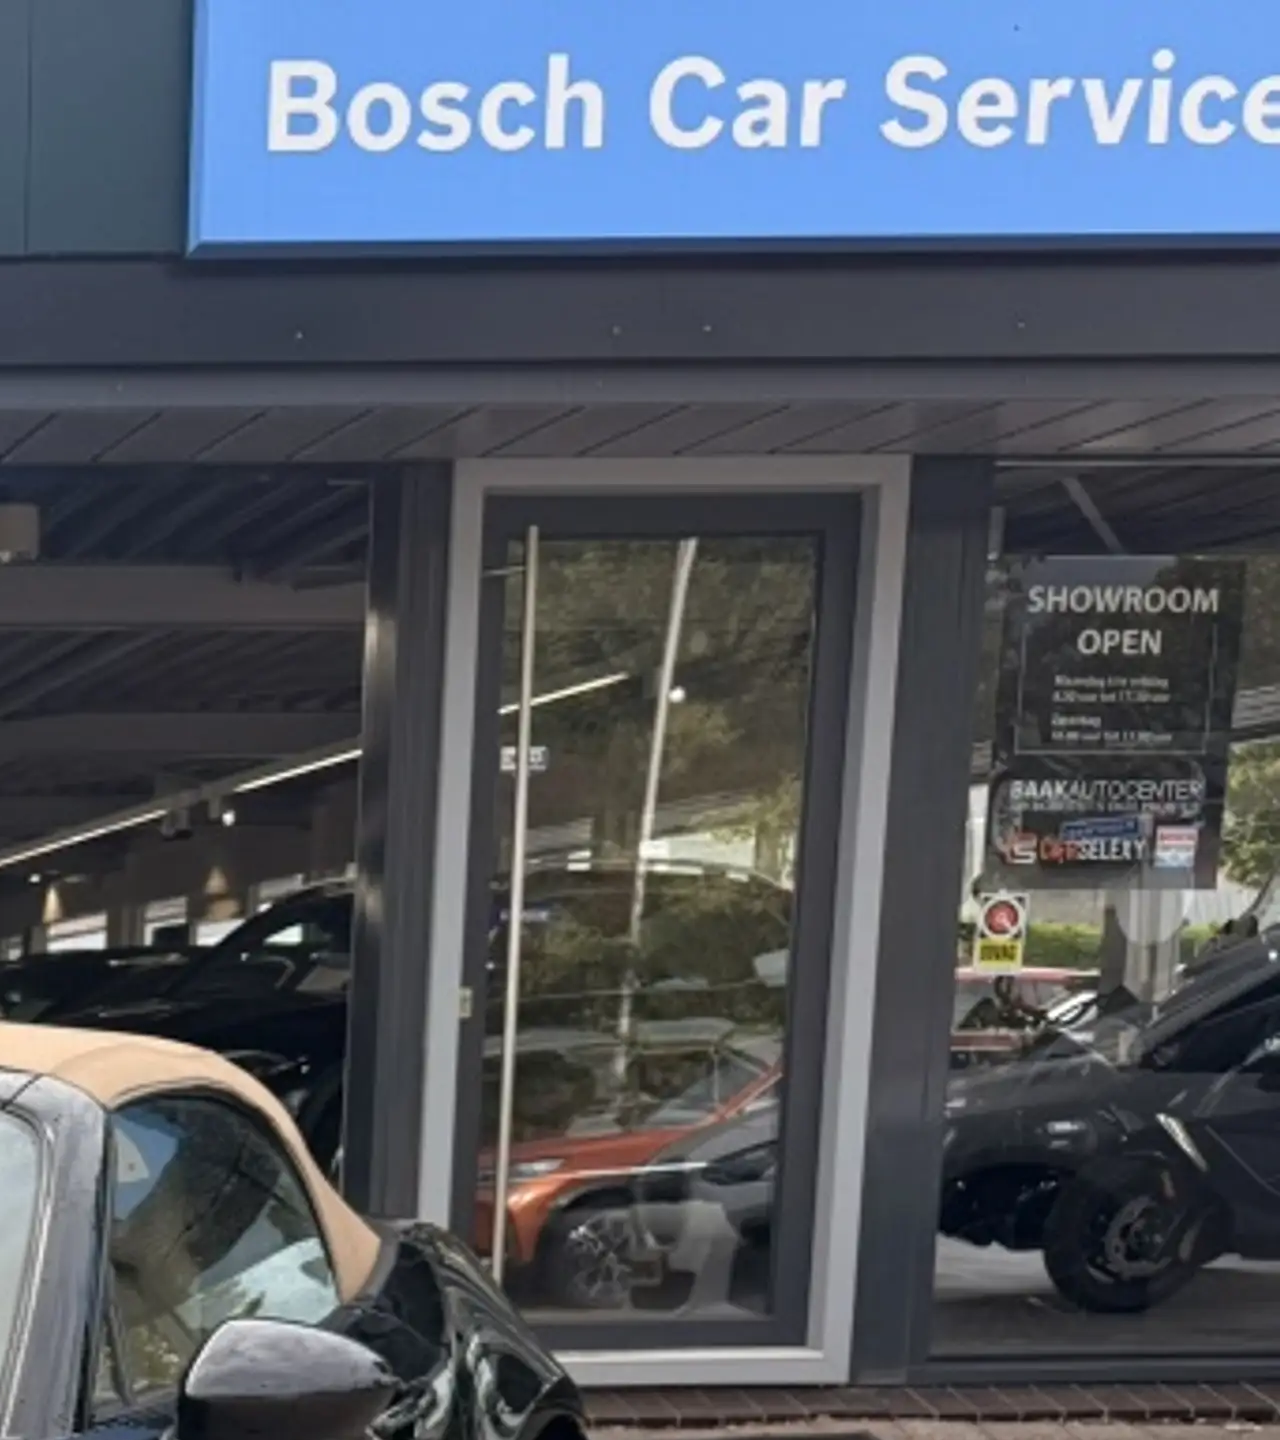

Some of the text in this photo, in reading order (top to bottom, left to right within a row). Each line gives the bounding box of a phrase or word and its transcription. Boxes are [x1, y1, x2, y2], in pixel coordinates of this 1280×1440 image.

[266, 48, 1280, 154] Bosch Car Service
[1027, 584, 1220, 614] SHOWROOM
[1076, 628, 1164, 656] OPEN
